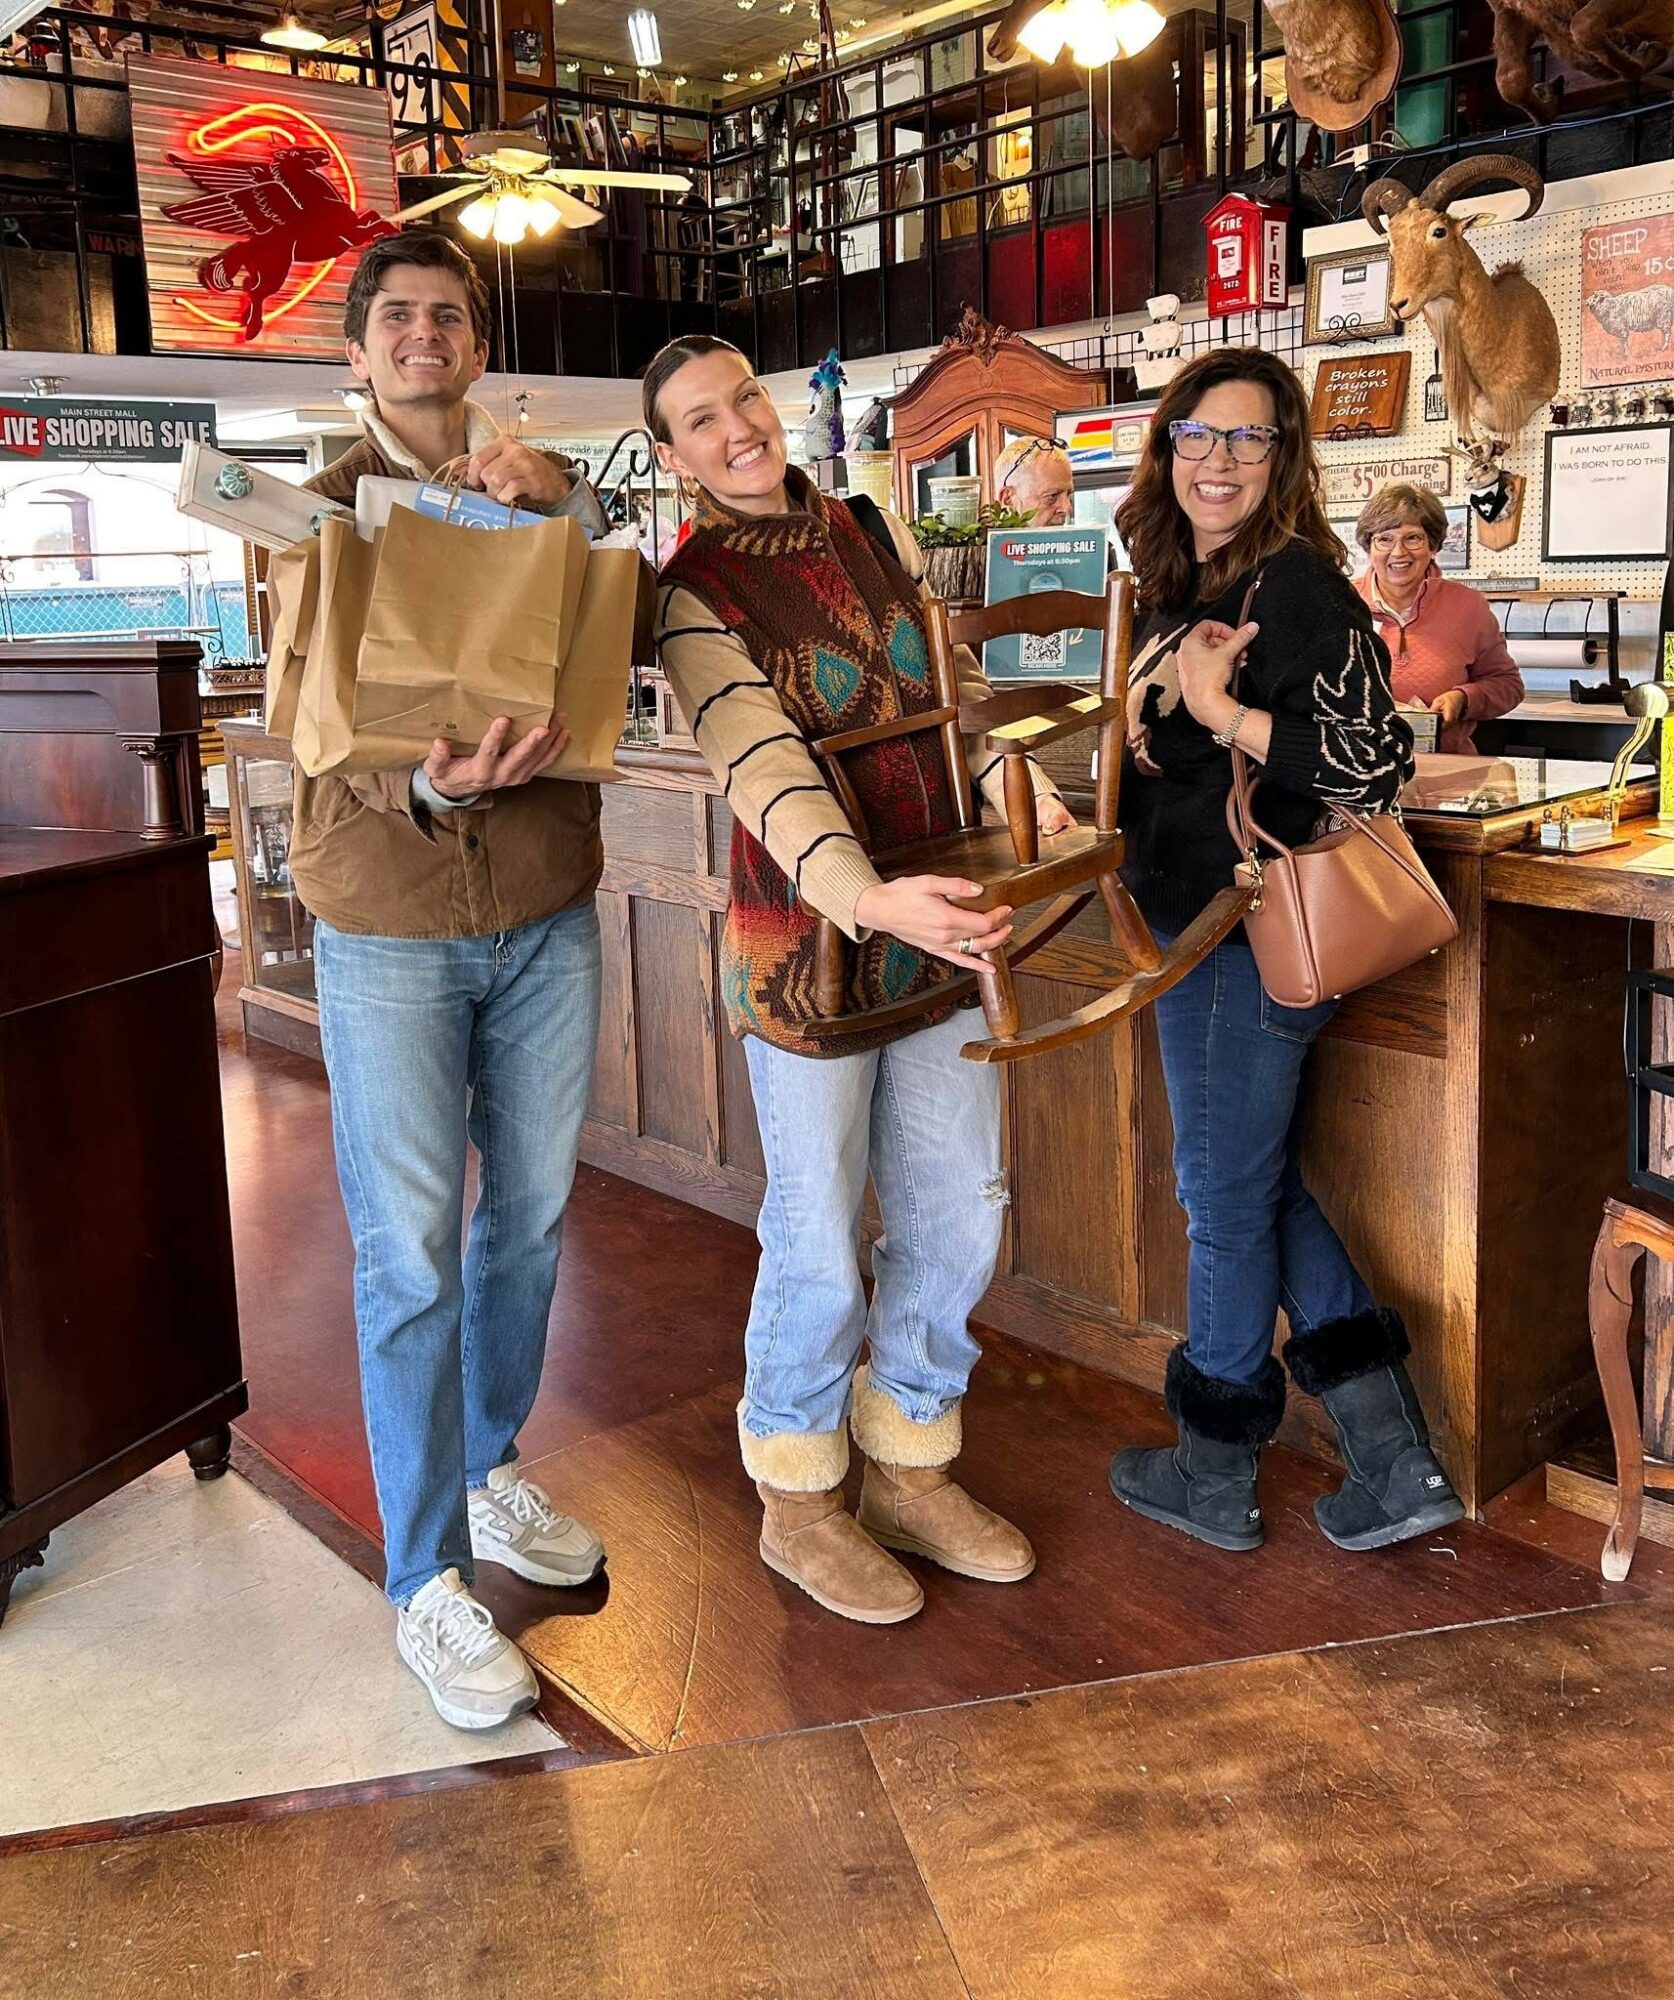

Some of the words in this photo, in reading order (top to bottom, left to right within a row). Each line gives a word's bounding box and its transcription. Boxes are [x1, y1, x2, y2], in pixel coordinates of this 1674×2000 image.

[1220, 216, 1243, 233] FIRE
[1587, 228, 1648, 260] SHEEP
[1269, 226, 1280, 298] FIRE
[1331, 368, 1388, 382] Broken
[1325, 378, 1389, 393] crayons
[1335, 392, 1368, 405] still
[60, 408, 83, 417] MAIN
[84, 408, 114, 418] STREET
[114, 409, 138, 418] MALL
[1329, 405, 1373, 417] color.
[45, 418, 155, 448] SHOPPING
[1575, 446, 1590, 455] AM
[1592, 445, 1613, 453] NOT
[1390, 461, 1440, 480] Charge
[1559, 461, 1580, 470] WAS
[1581, 460, 1609, 469] BORN
[1611, 459, 1625, 467] TO
[1627, 458, 1642, 466] DO
[1409, 479, 1446, 492] hining
[1007, 544, 1026, 556] LIVE
[1027, 542, 1072, 555] SHOPPING
[1073, 540, 1096, 553] SALE
[1013, 558, 1047, 567] Thursdays
